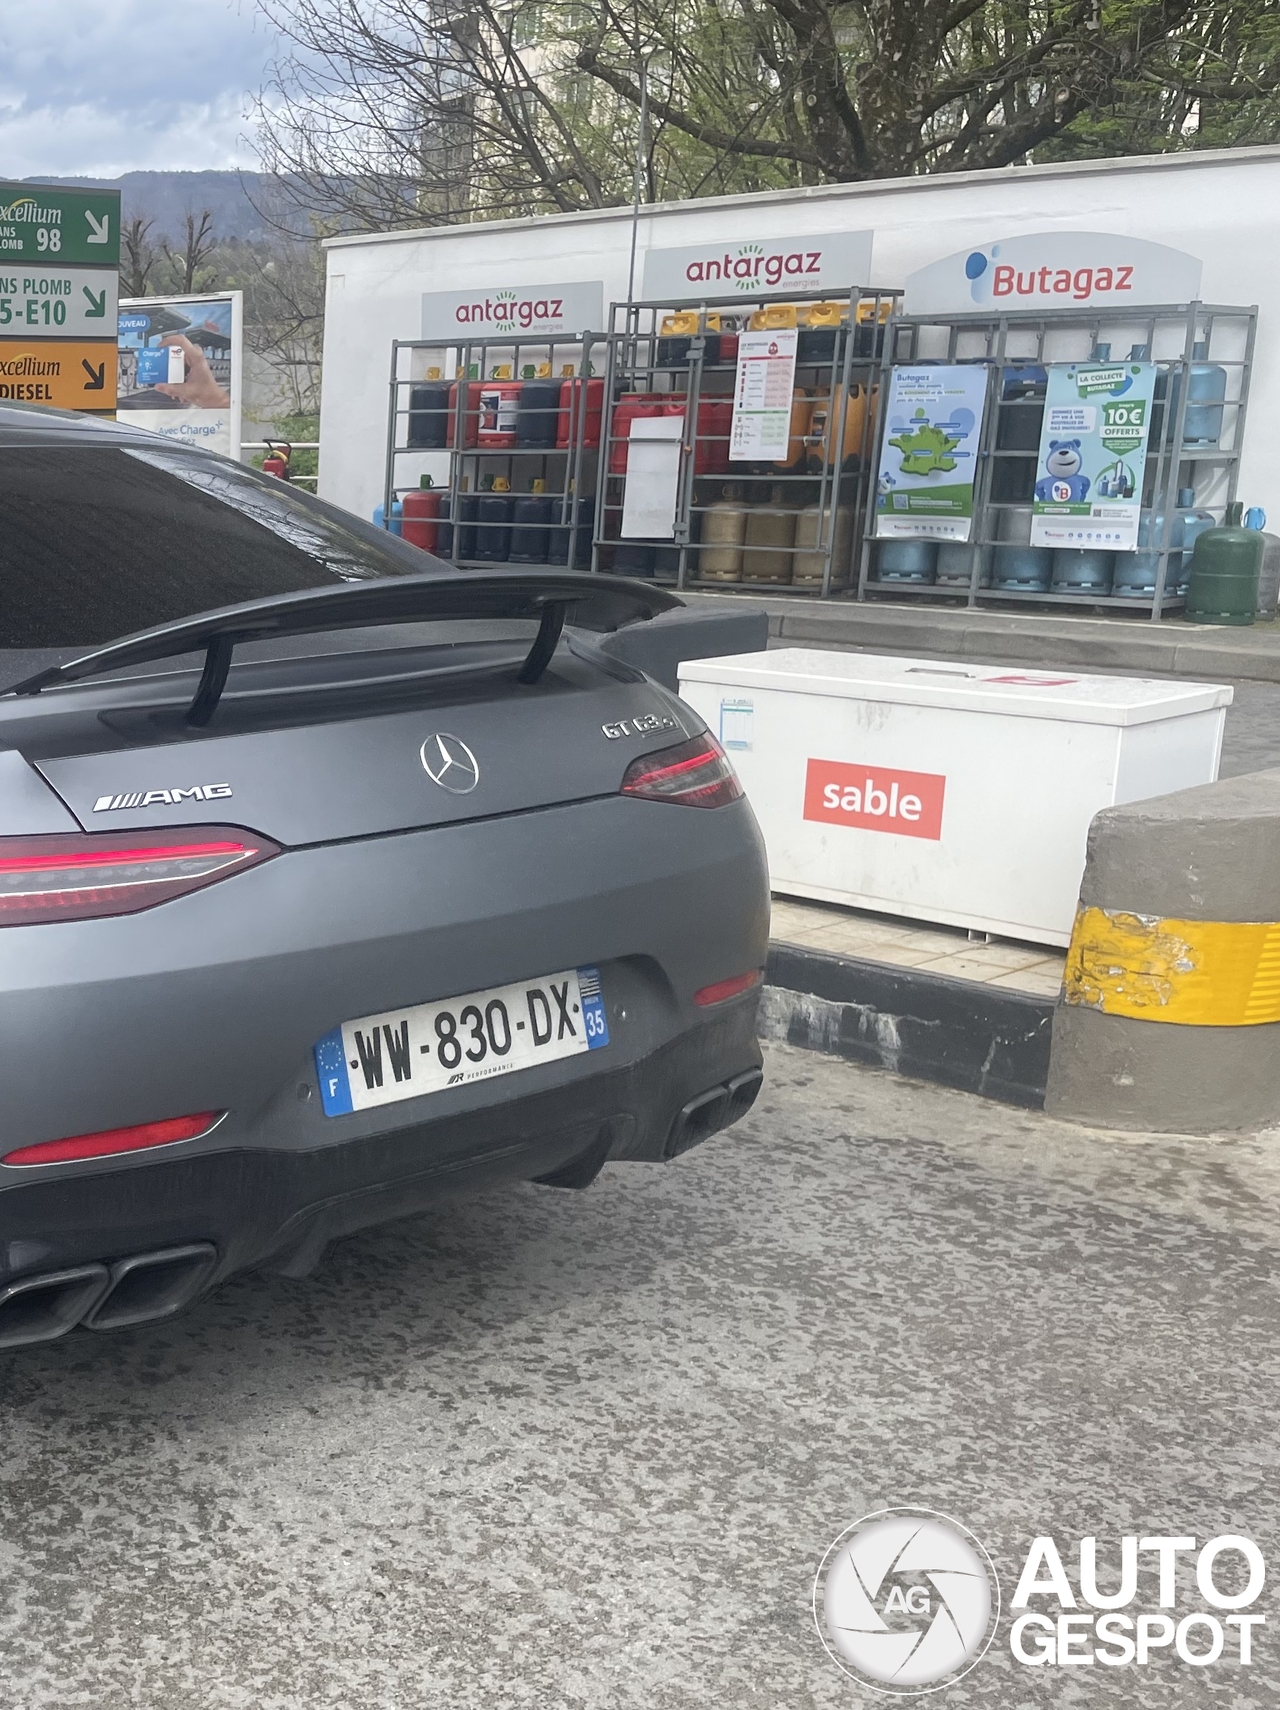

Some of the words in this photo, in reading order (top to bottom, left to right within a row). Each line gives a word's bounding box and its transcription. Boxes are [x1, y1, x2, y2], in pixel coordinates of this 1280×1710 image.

[36, 228, 62, 252] 98
[686, 252, 822, 285] antargaz
[23, 278, 72, 296] PLOMB
[782, 279, 820, 289] energies
[993, 265, 1134, 300] Butagaz
[455, 299, 563, 328] antargaz
[118, 320, 146, 328] OUVEAU
[533, 323, 563, 332] energies
[897, 374, 930, 383] Butagaz
[1080, 374, 1089, 382] LA
[1091, 372, 1123, 382] COLLECTE
[1087, 383, 1116, 392] BUTAGAZ
[1108, 408, 1142, 425] 10€
[158, 427, 178, 435] Avec
[179, 424, 217, 437] Charge
[1104, 428, 1140, 436] OFFERTS
[601, 720, 631, 739] GT
[140, 782, 233, 807] AMG
[823, 778, 923, 821] sable
[586, 1009, 605, 1037] 35
[354, 981, 577, 1090] WW-830-DX
[467, 1062, 514, 1080] PERFORMANCE
[328, 1078, 339, 1098] F
